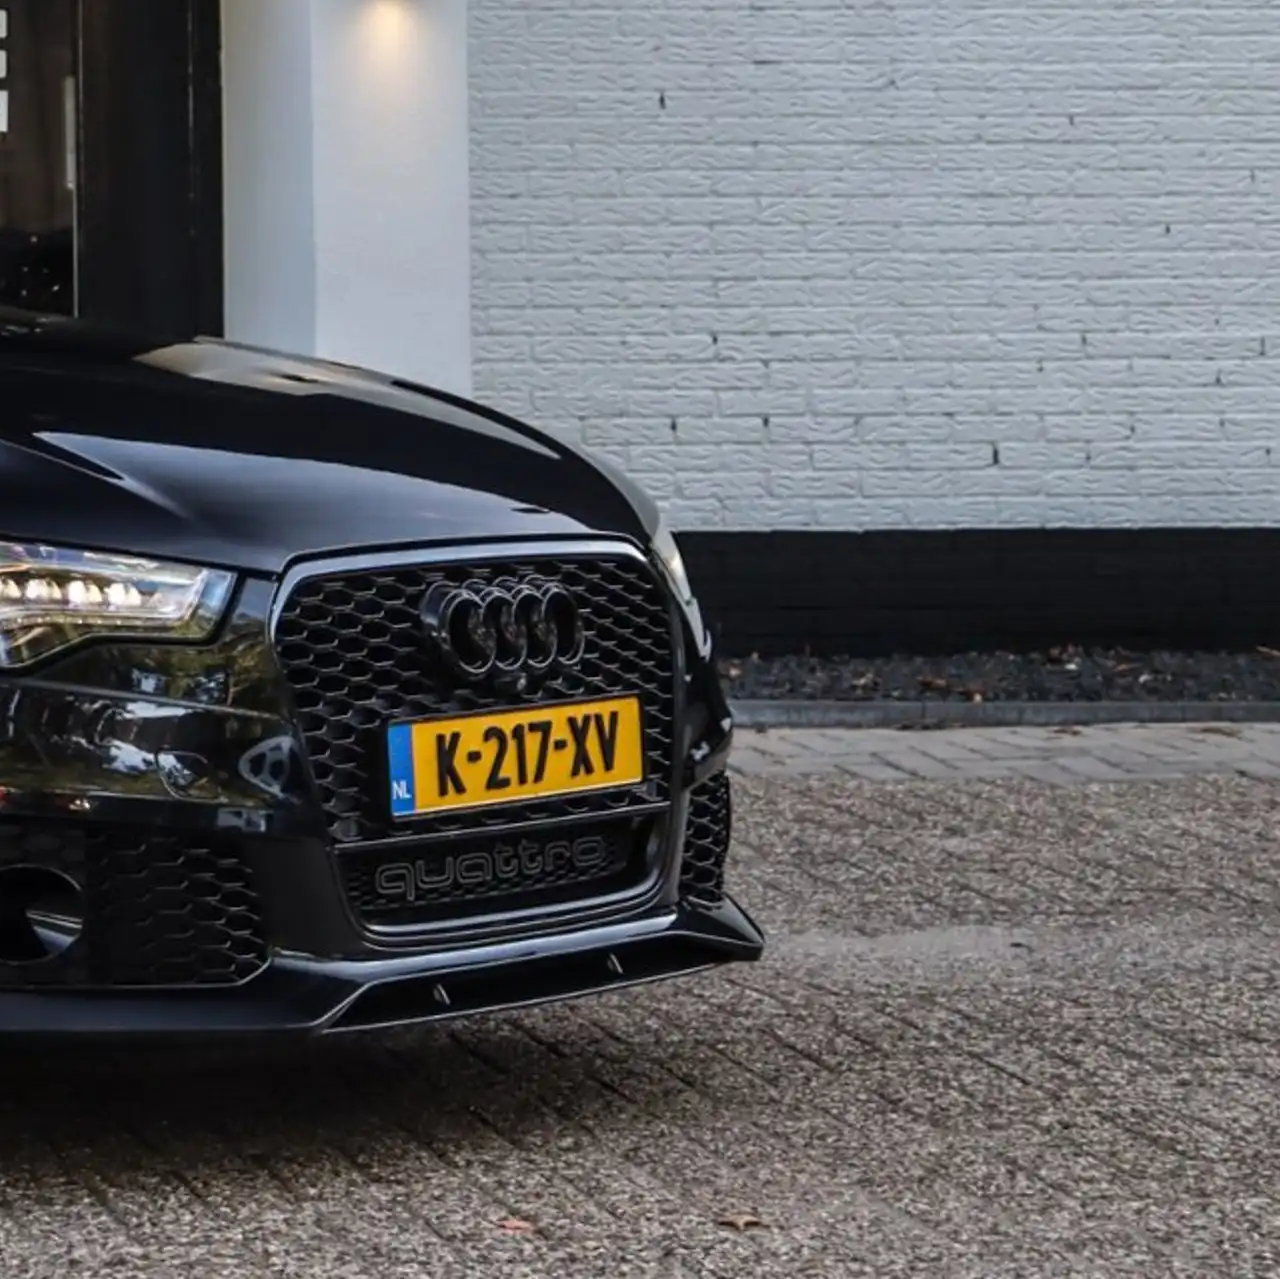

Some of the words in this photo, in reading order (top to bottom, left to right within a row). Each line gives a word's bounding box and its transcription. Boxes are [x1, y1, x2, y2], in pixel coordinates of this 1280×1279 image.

[435, 711, 619, 797] K-217-XV
[392, 782, 412, 800] NL
[375, 837, 605, 900] quattro
